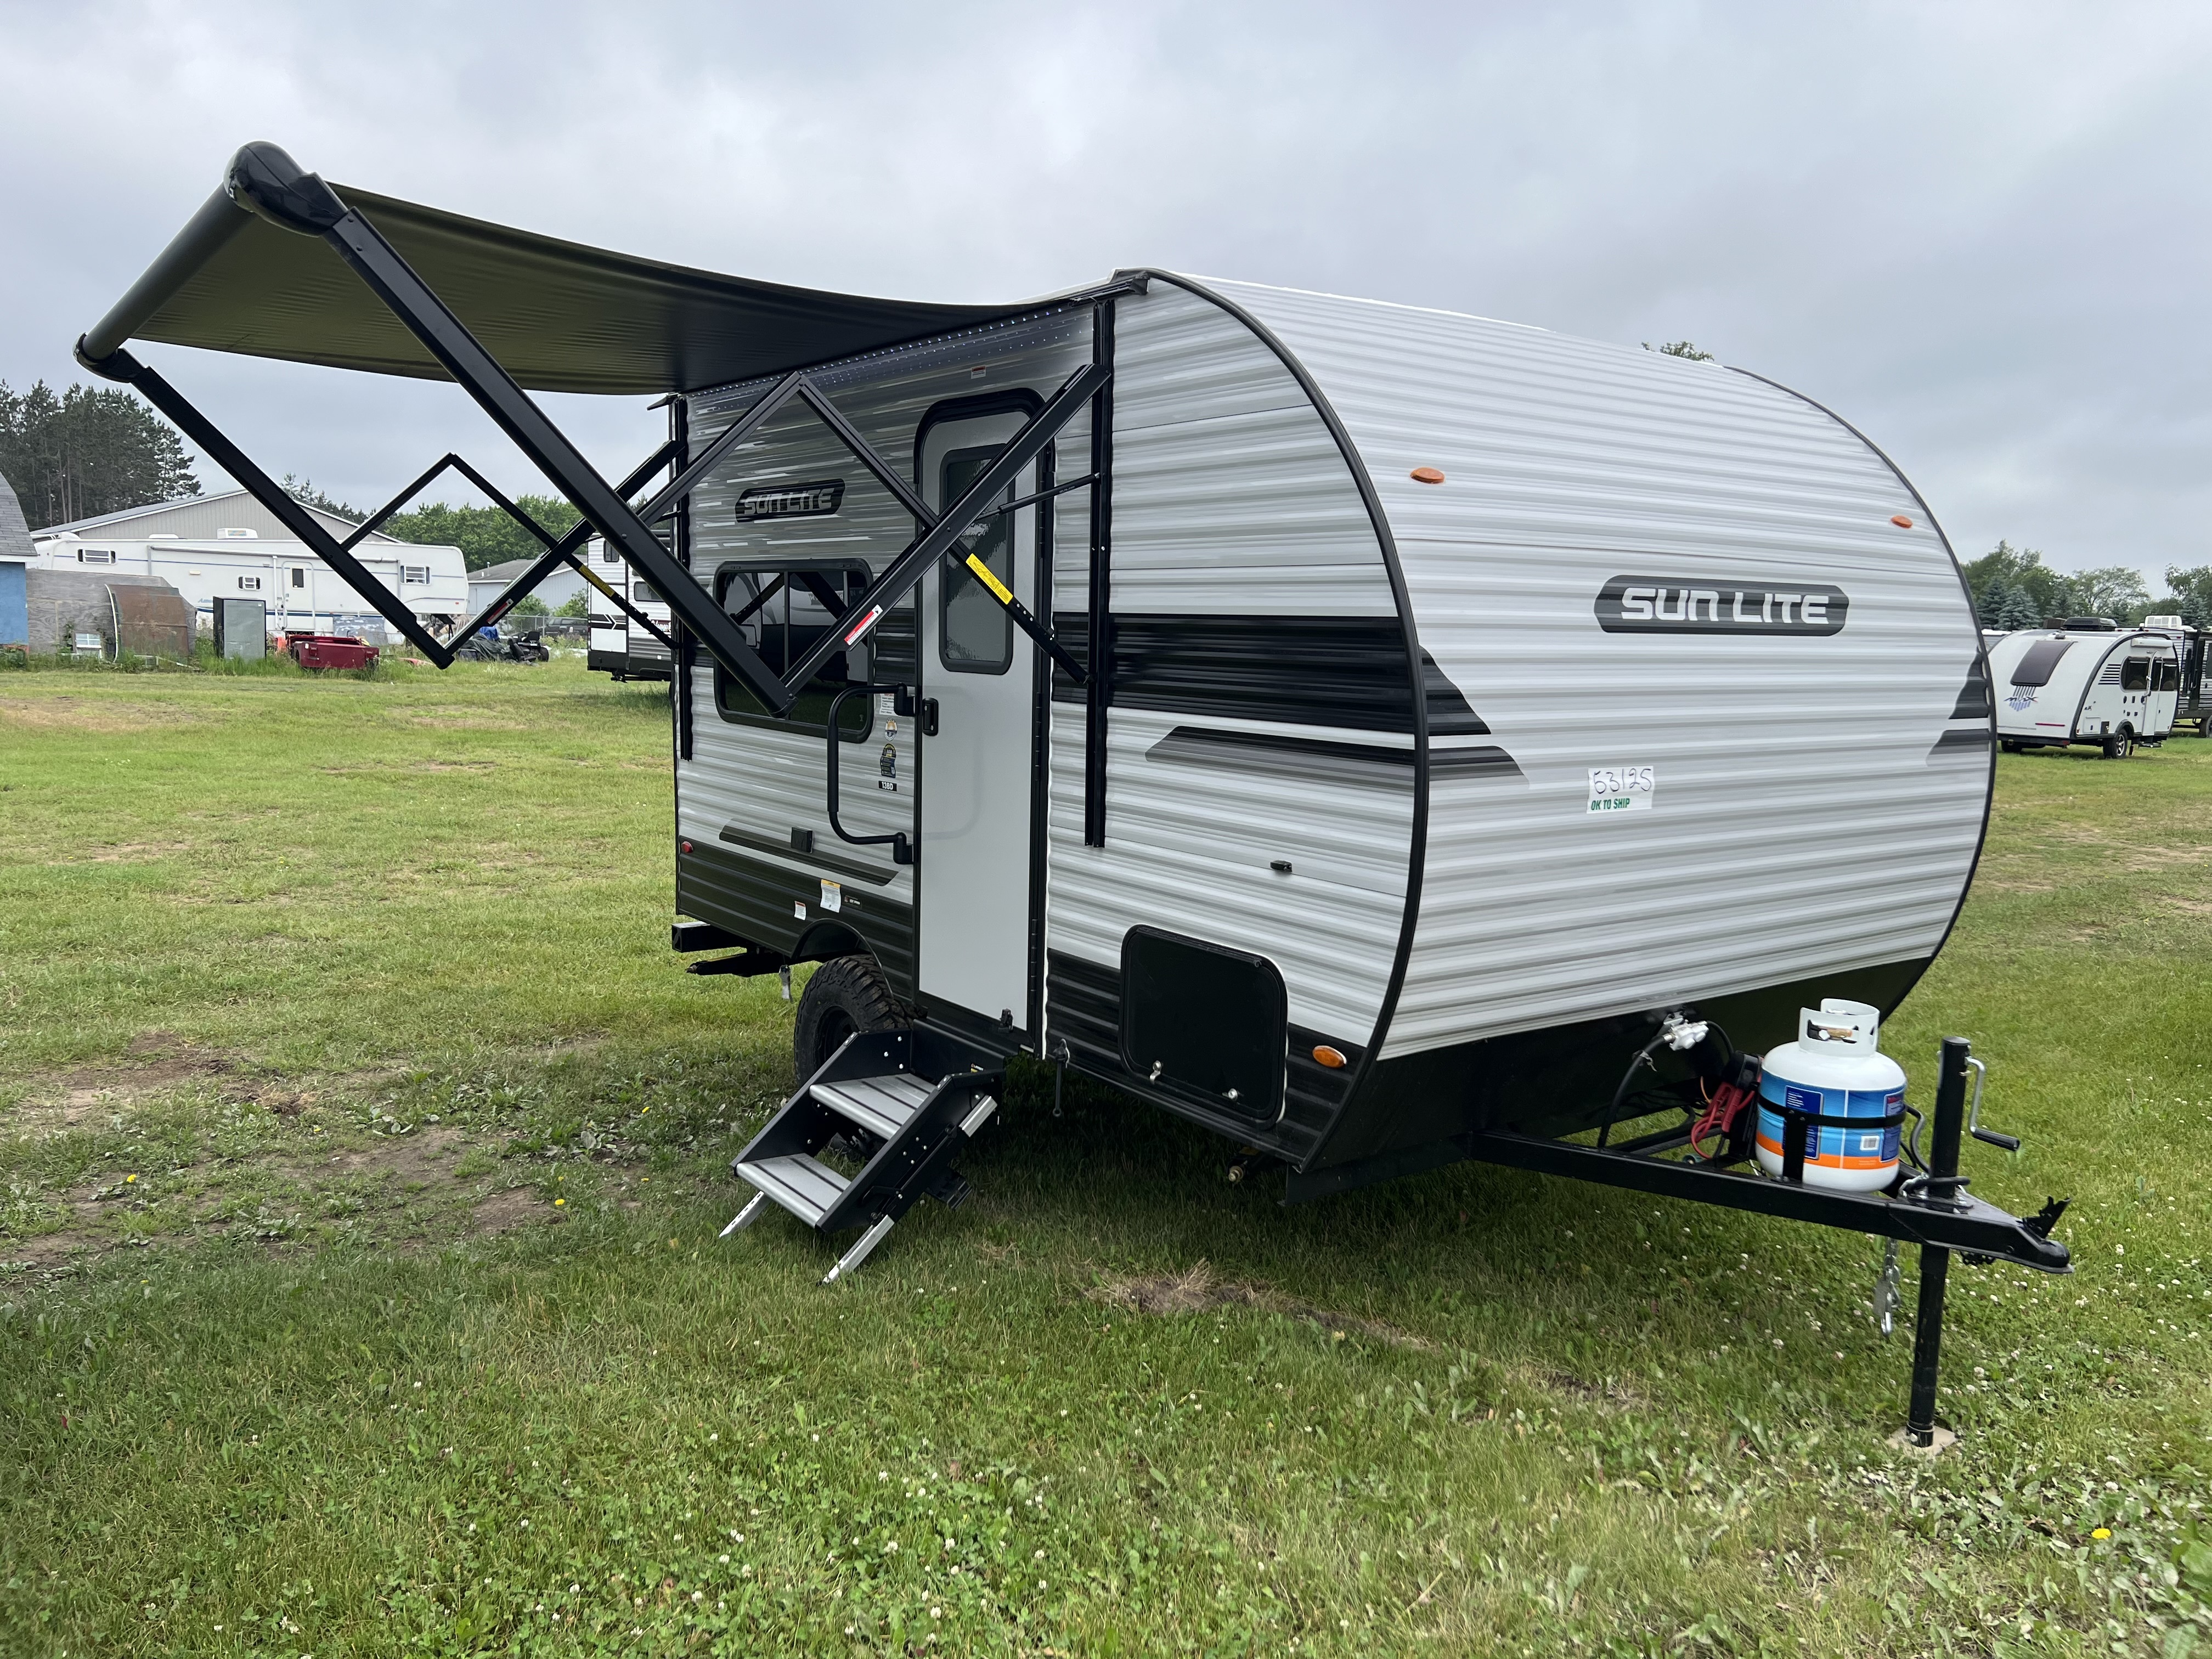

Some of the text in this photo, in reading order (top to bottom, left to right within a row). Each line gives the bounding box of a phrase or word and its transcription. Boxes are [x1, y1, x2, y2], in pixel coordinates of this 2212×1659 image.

[1621, 587, 1829, 624] SUN LITE
[1593, 768, 1651, 794] 53125
[1591, 798, 1630, 810] OK TO SHIP
